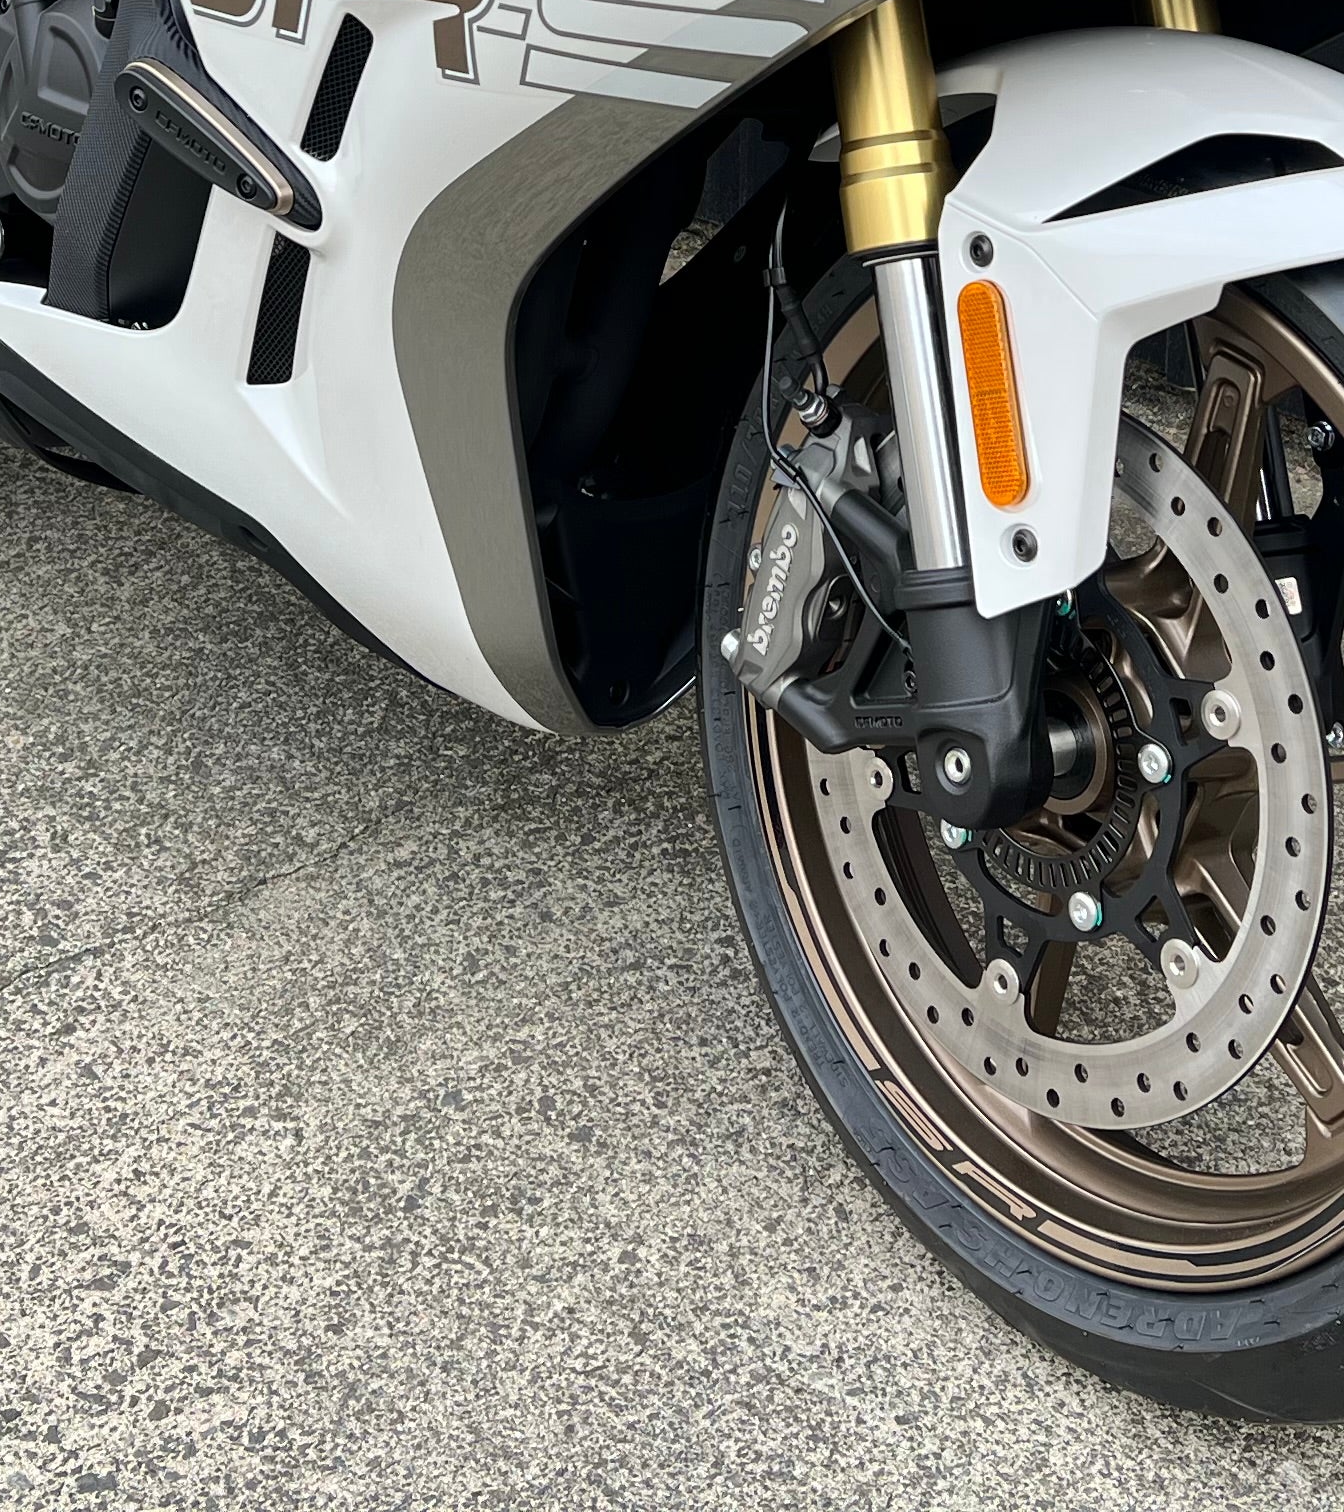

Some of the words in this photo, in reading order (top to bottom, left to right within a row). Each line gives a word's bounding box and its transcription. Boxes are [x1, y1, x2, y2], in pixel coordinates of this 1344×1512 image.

[153, 109, 227, 176] CFMOTO
[746, 522, 799, 657] brembo
[952, 1219, 1027, 1279] HS
[1033, 1270, 1246, 1342] ADRENO
